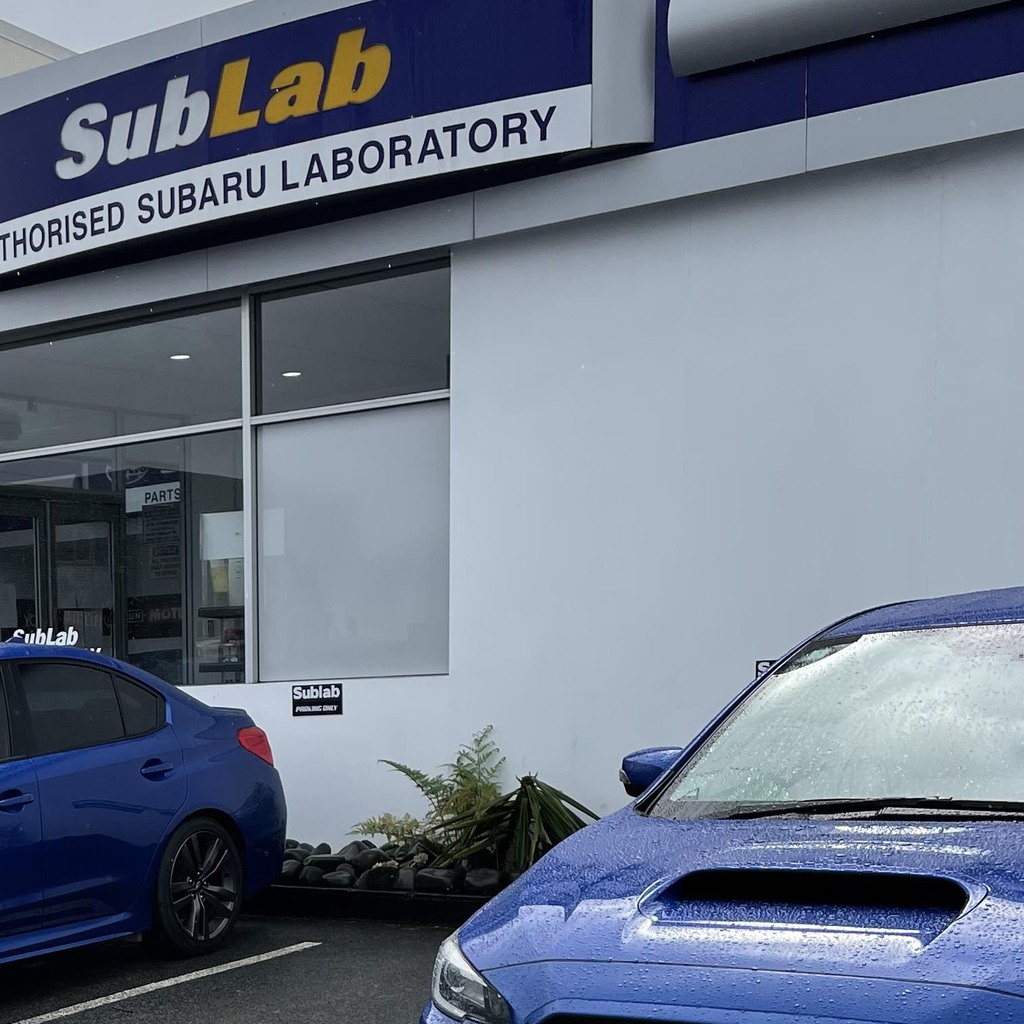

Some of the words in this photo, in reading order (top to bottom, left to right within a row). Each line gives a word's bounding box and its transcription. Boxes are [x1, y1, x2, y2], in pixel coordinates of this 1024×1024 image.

[55, 27, 392, 181] SubLab
[137, 165, 267, 224] SUBARU
[281, 105, 558, 192] LABORATORY
[144, 487, 181, 505] PARTS
[12, 626, 79, 646] SubLab
[293, 685, 341, 700] Sublab
